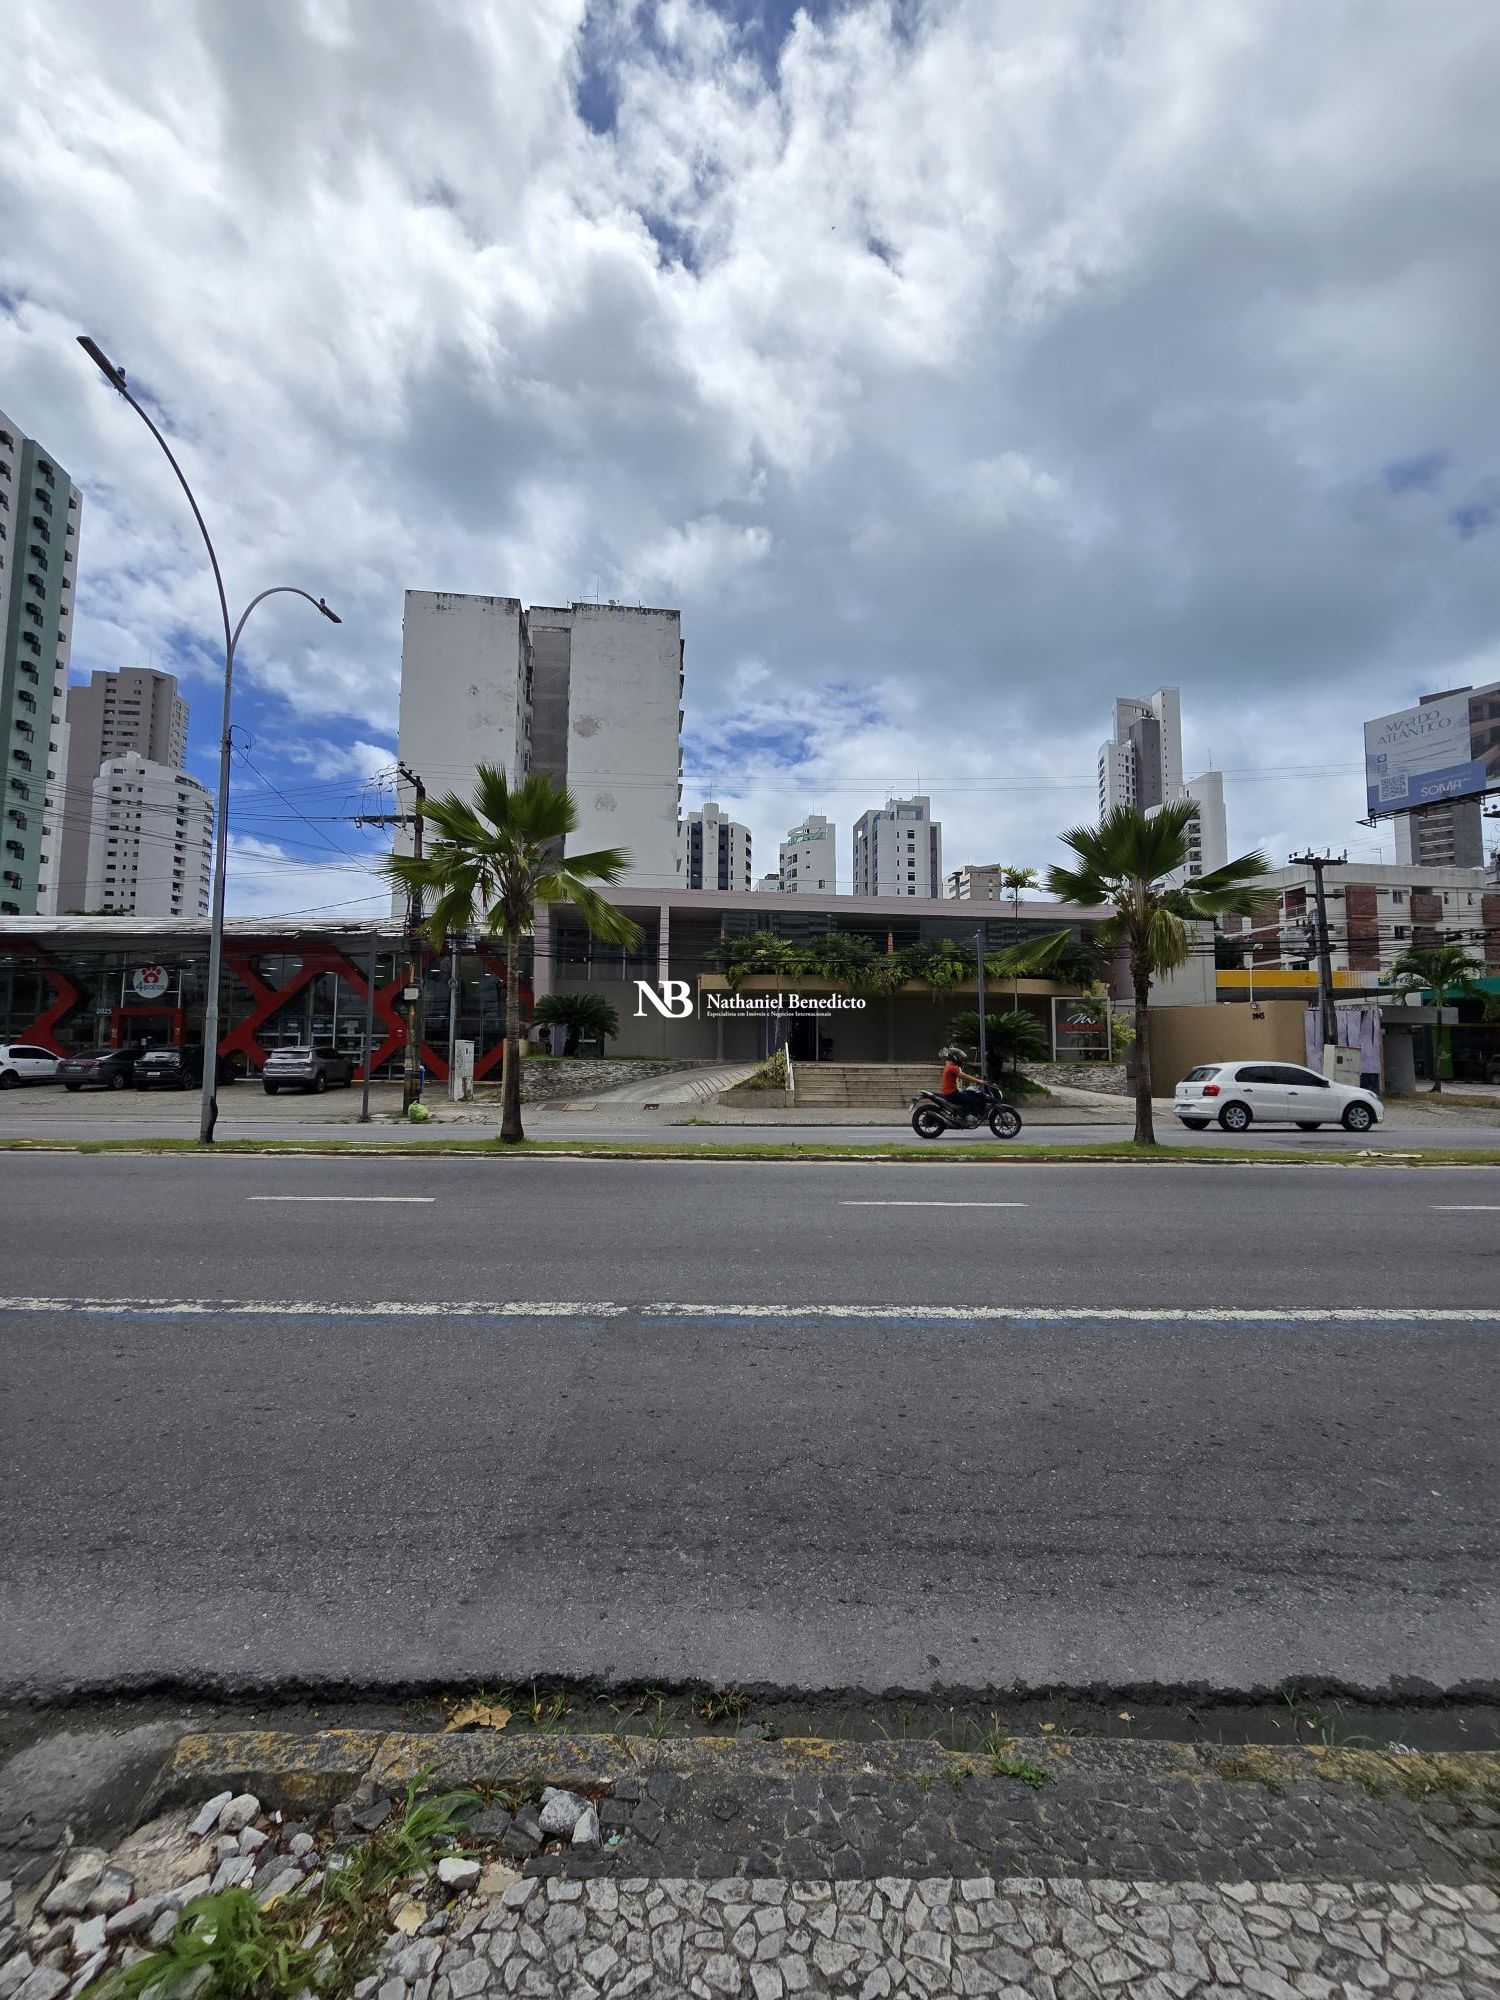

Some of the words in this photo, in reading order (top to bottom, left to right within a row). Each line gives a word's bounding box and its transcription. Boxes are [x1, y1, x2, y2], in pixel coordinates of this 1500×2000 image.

[1386, 717, 1415, 731] MAR
[1418, 710, 1440, 725] DO
[1420, 780, 1462, 797] SOMA
